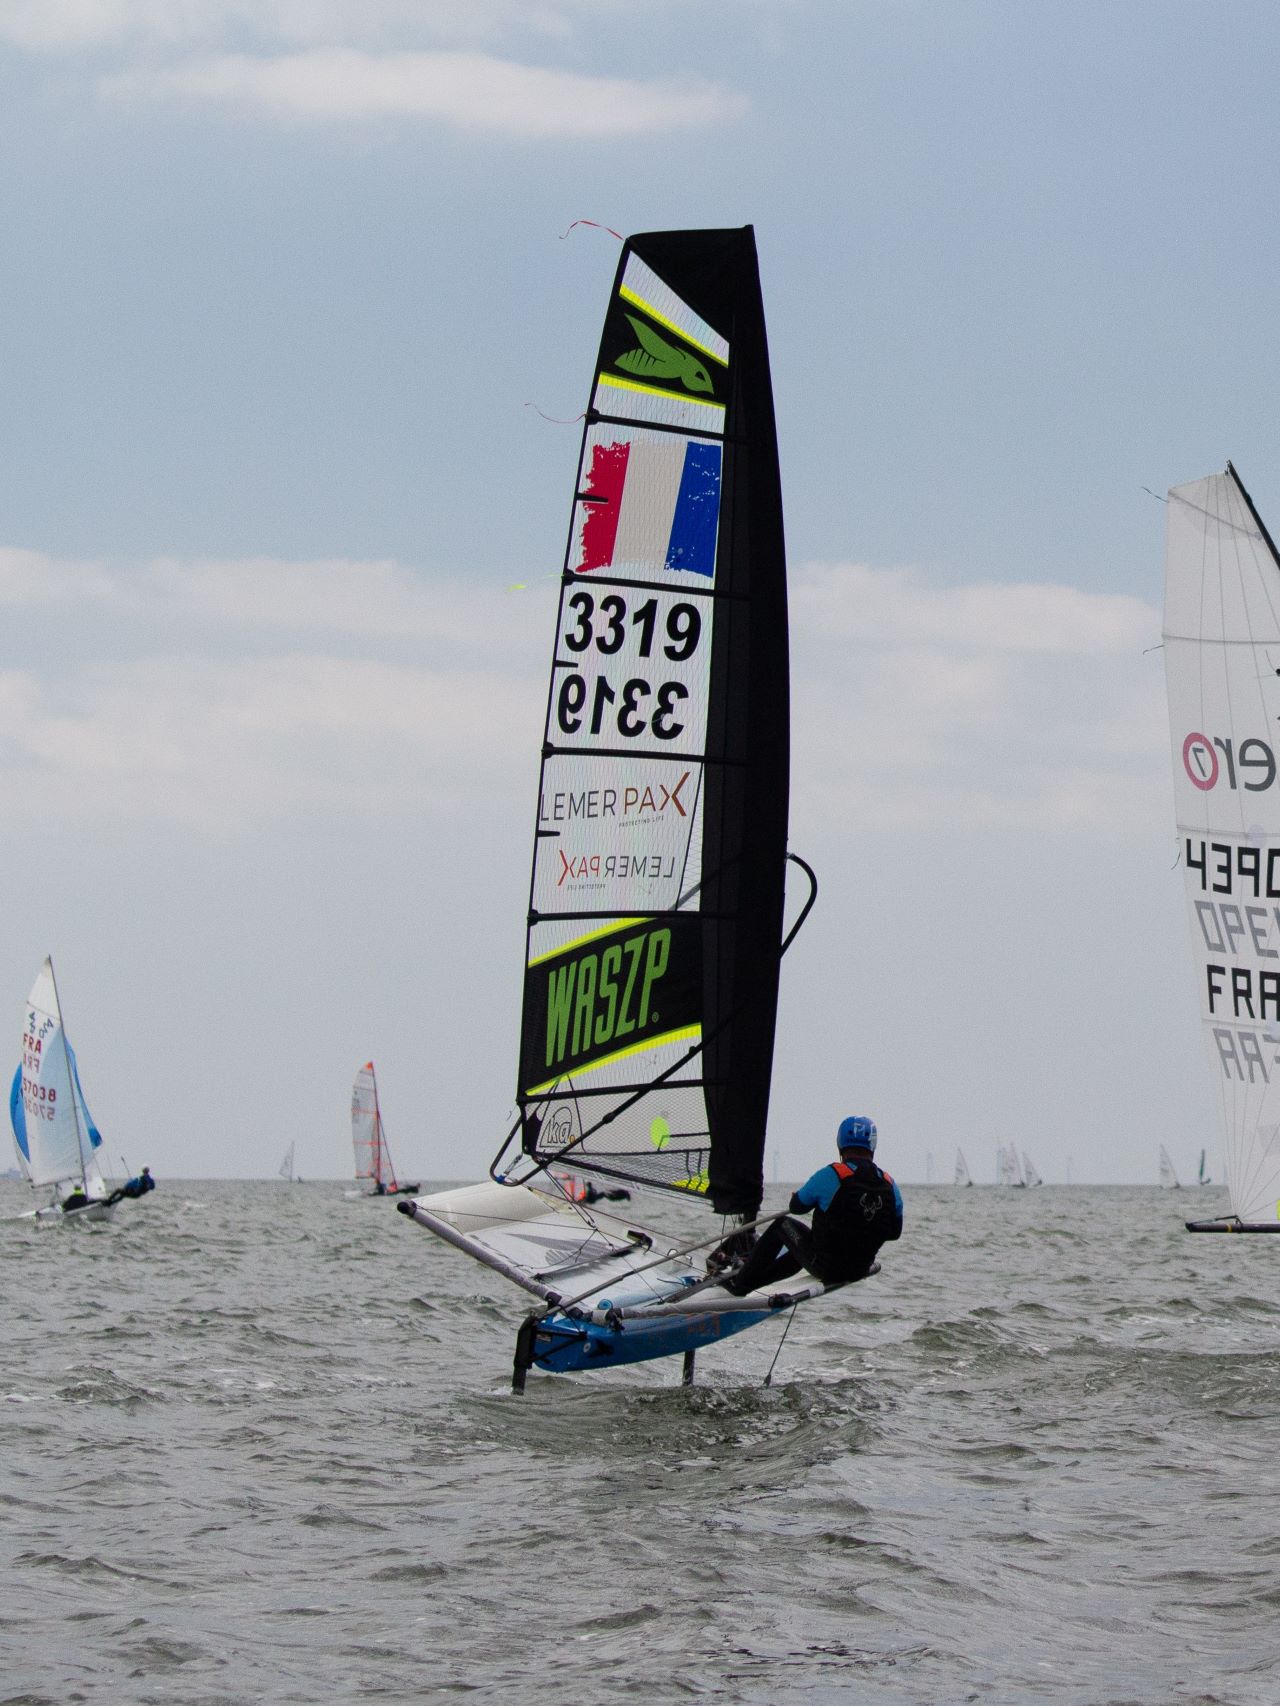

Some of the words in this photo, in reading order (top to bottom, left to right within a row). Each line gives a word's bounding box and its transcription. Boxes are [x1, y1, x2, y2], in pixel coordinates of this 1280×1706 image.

[565, 592, 702, 662] 3319
[540, 789, 617, 822] LEMER
[624, 772, 691, 817] PAX
[546, 928, 672, 1068] WASZP
[23, 1033, 42, 1054] FRA
